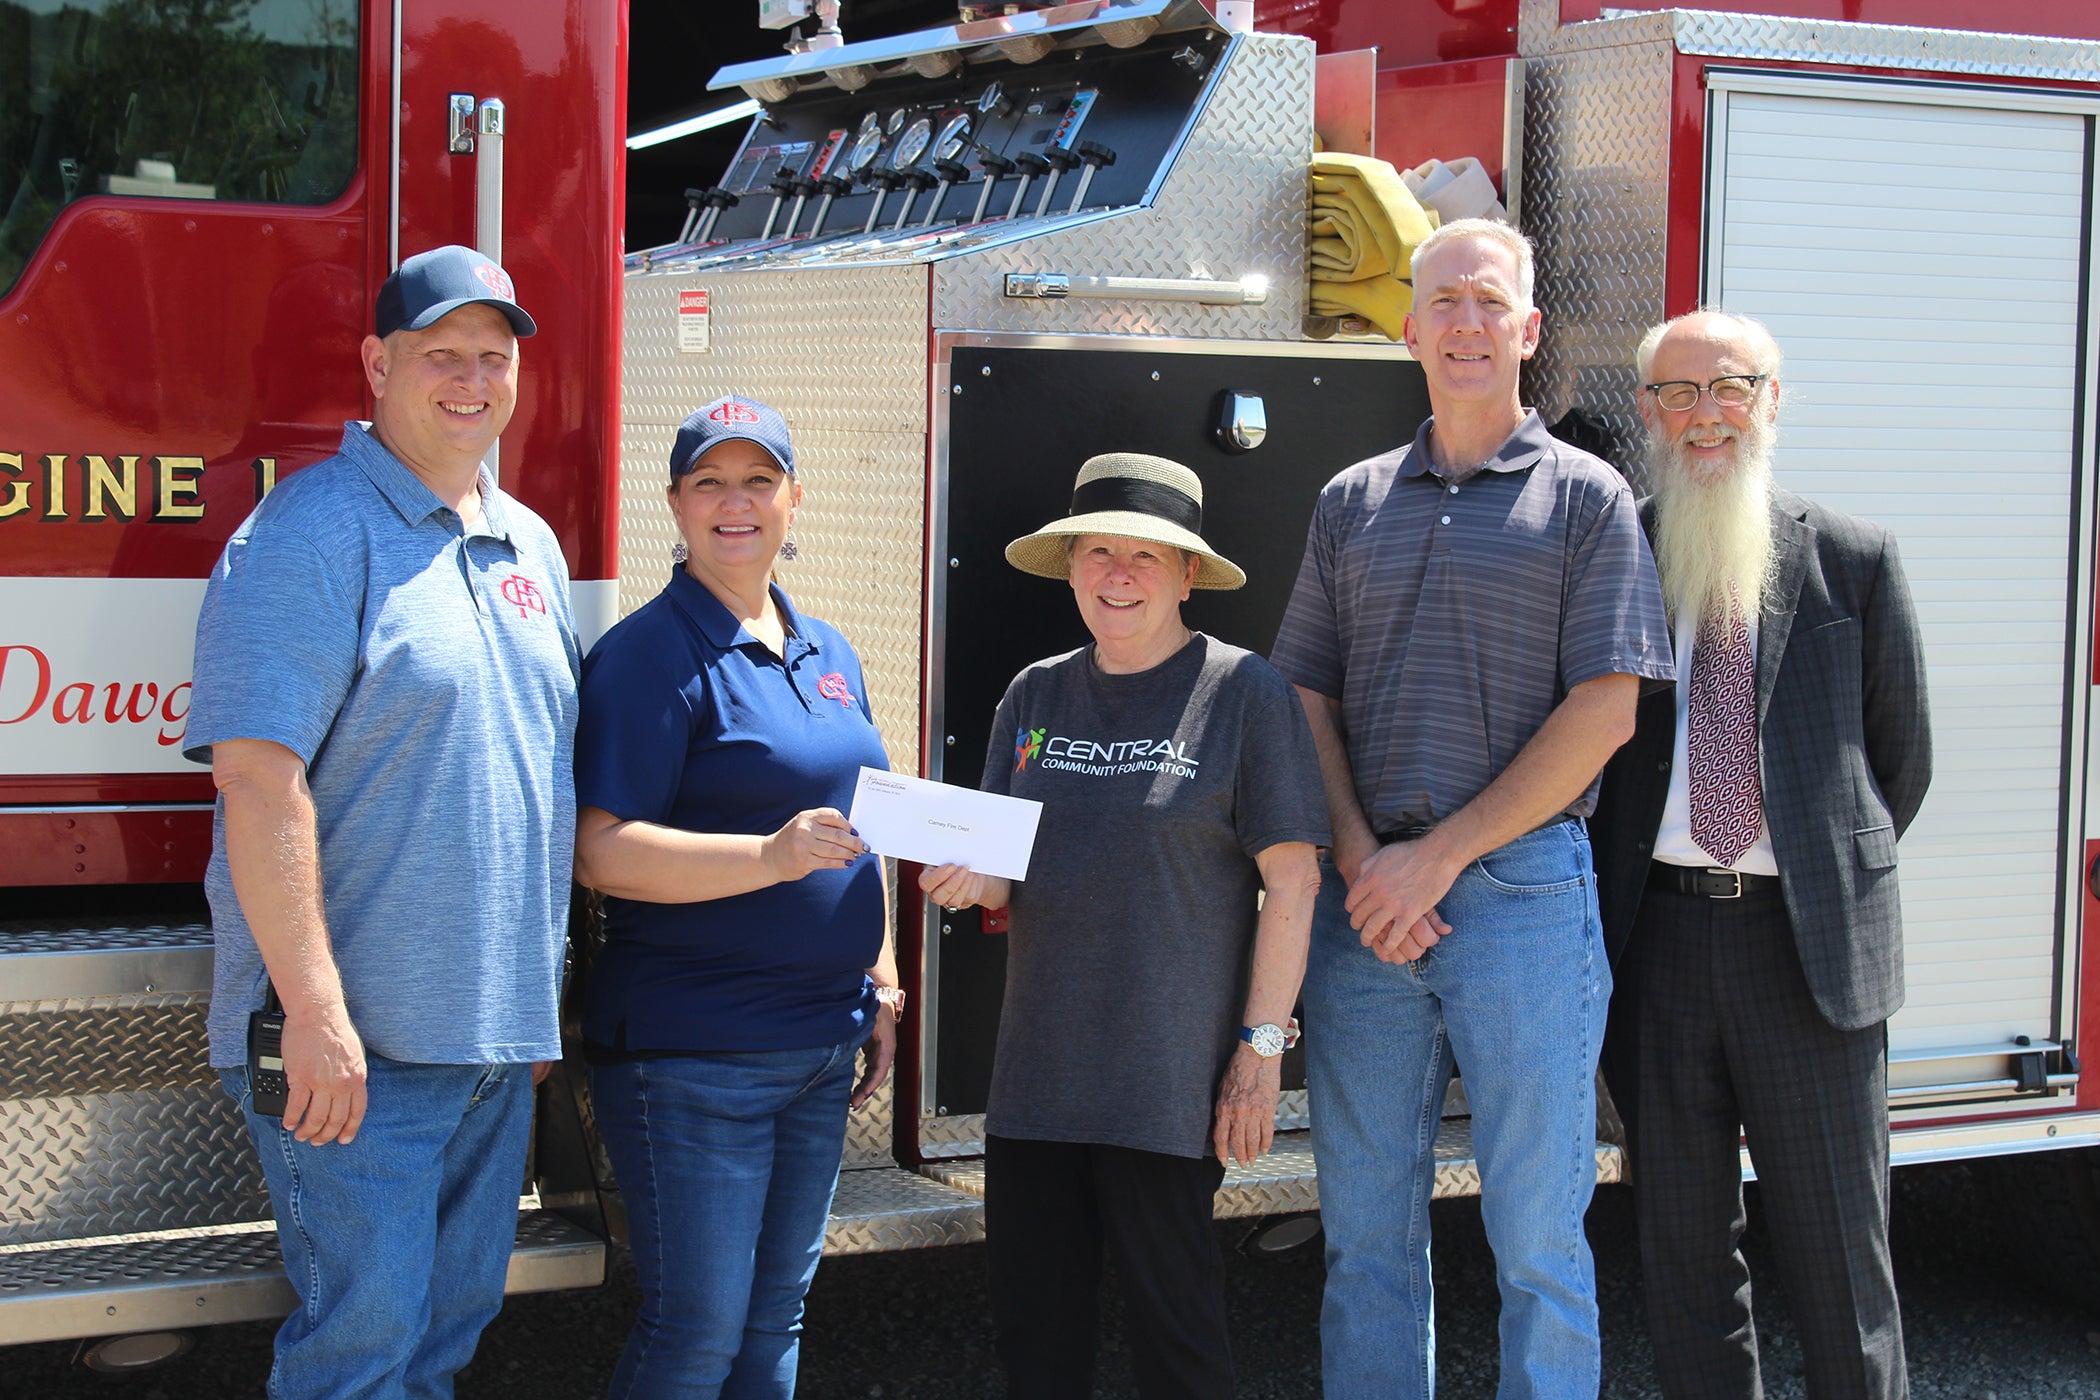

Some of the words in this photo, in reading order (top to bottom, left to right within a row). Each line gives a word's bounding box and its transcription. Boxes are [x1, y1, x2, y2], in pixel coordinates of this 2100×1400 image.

[1046, 736, 1199, 766] CENTRAL
[1041, 758, 1117, 777] COMMUNITY
[1117, 760, 1197, 779] FOUNDATION
